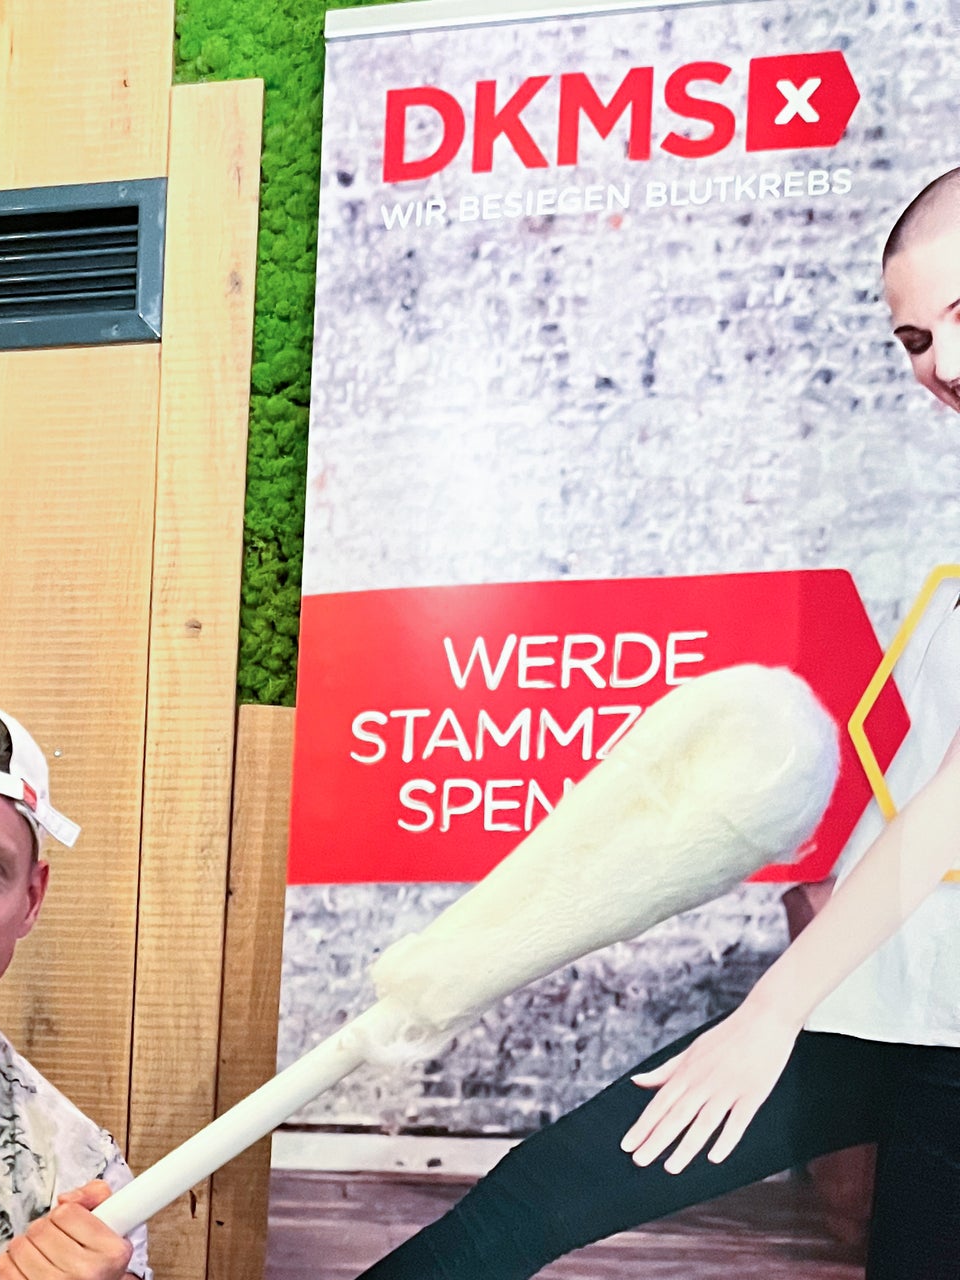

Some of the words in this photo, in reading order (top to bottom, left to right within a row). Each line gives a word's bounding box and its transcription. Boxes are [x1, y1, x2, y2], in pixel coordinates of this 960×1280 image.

[382, 61, 736, 183] DKMS
[380, 199, 446, 231] WIR
[458, 182, 631, 222] BESIEGEN
[645, 168, 854, 209] BLUTKREBS
[443, 630, 709, 690] WERDE
